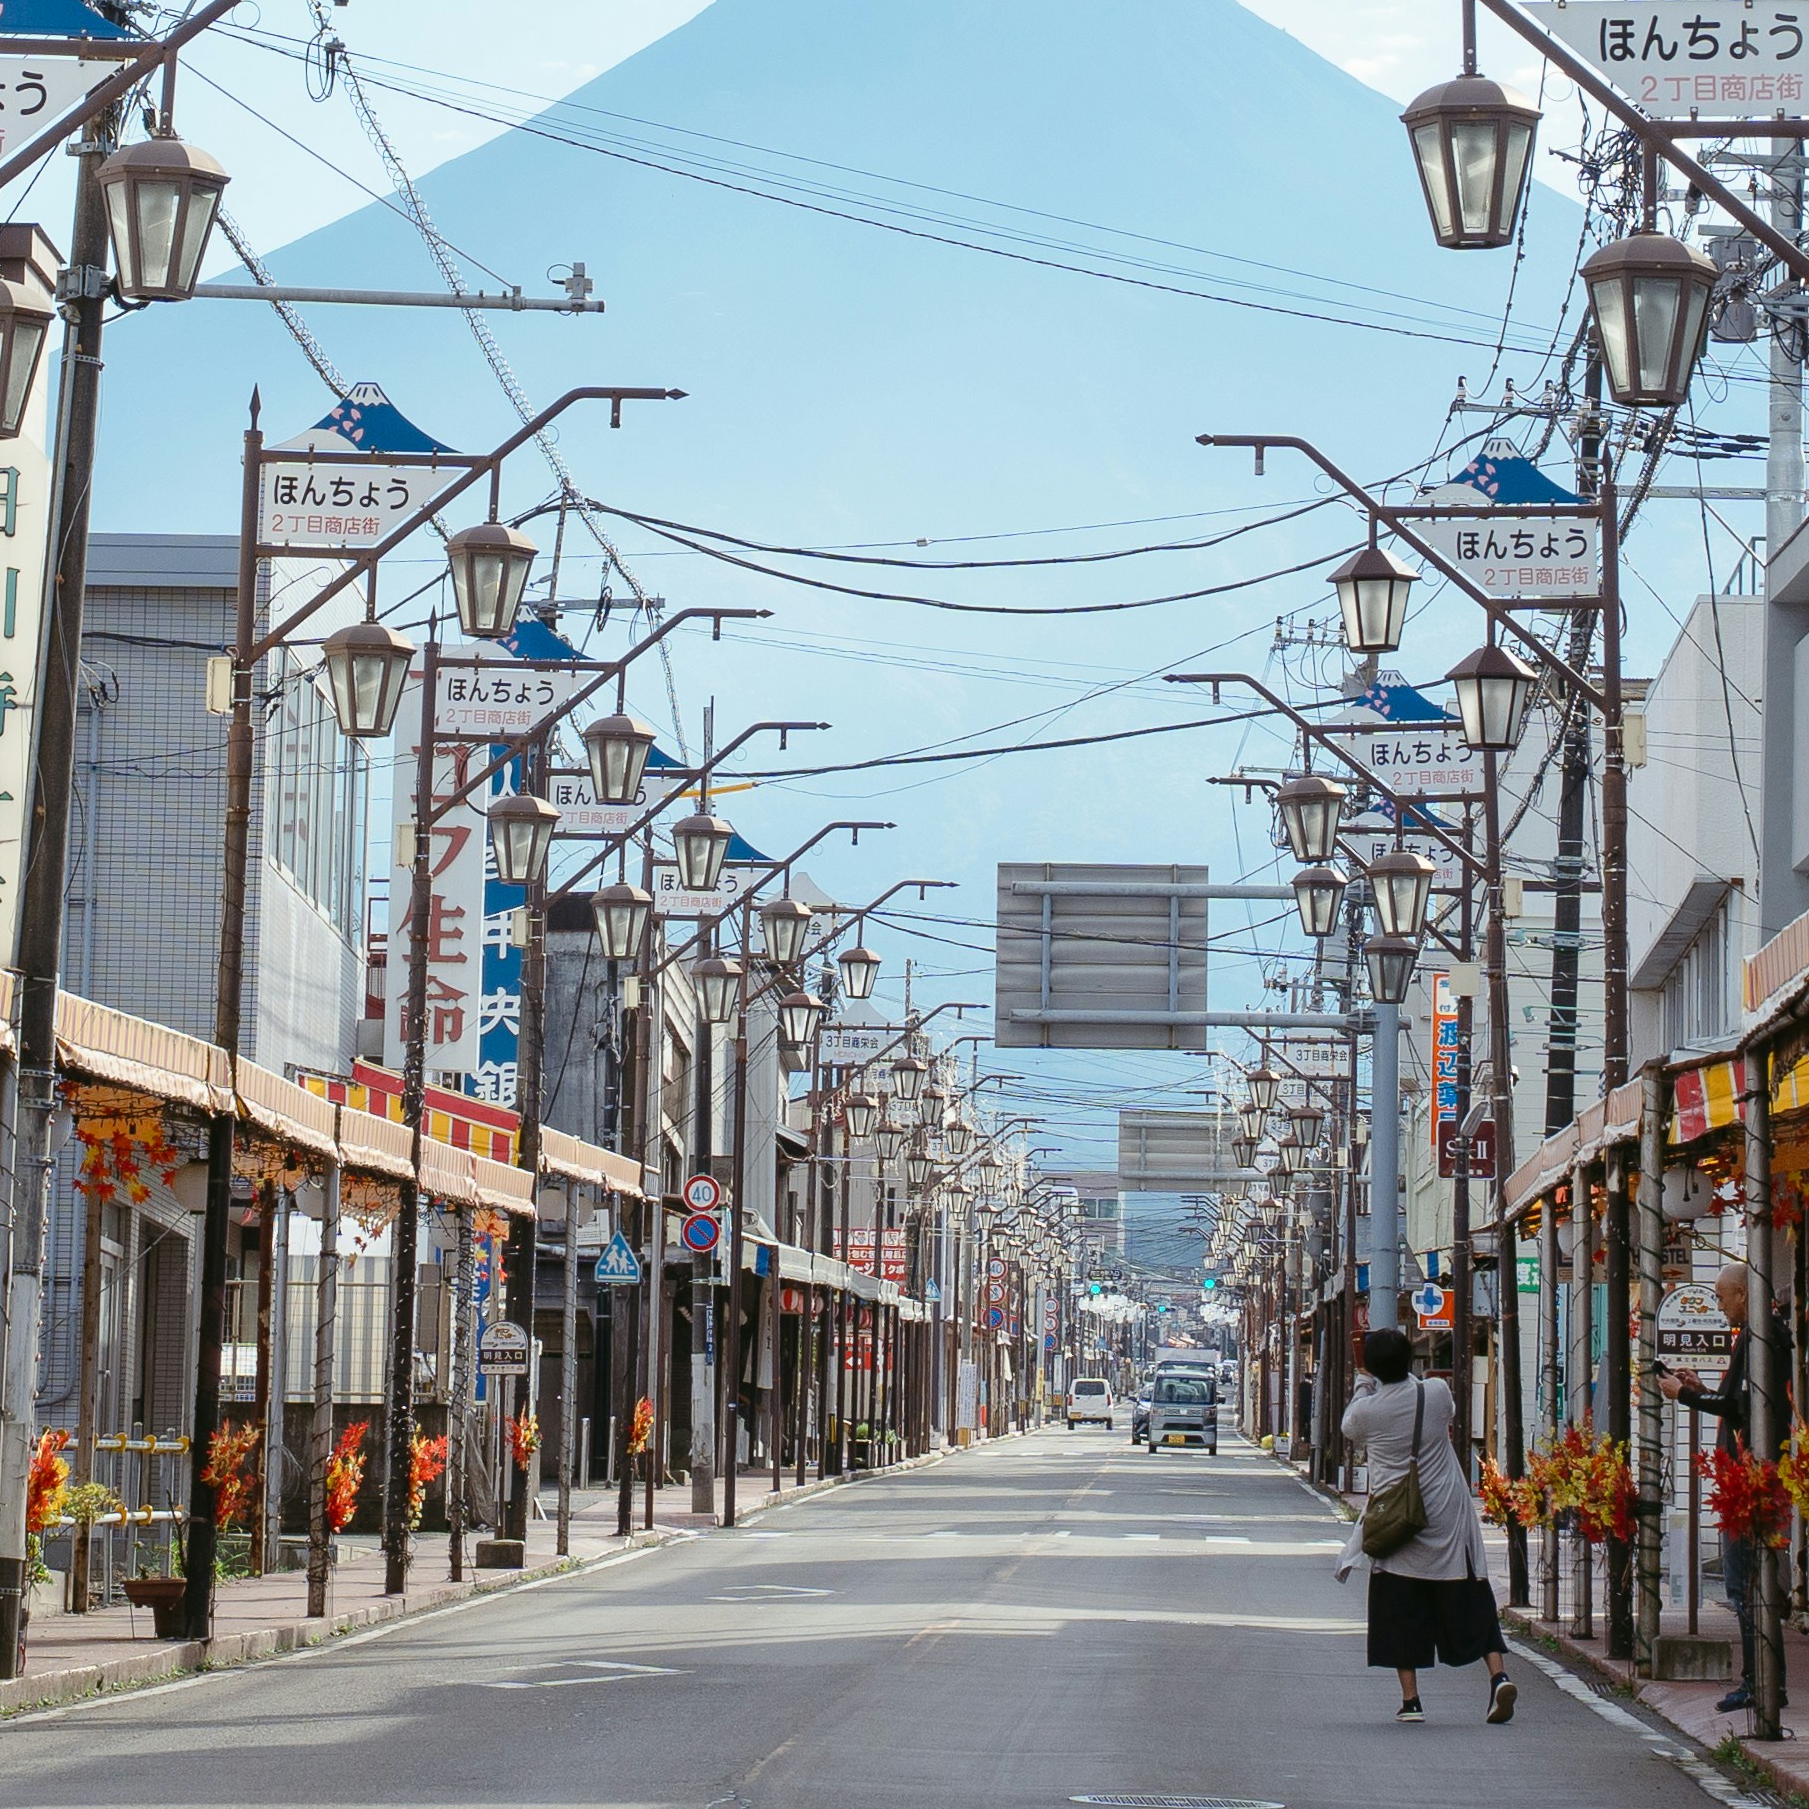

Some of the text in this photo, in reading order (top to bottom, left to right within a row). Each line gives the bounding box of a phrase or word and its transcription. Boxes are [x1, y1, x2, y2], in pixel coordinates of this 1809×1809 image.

[1599, 13, 1804, 63] ほんちょう
[1640, 73, 1804, 103] 2丁目商店街
[274, 473, 410, 511] ほんちょう
[271, 513, 380, 536] 2丁目商店街
[1455, 527, 1589, 561] ほんちょう
[1484, 566, 1590, 587] 2丁目商店街
[447, 676, 555, 707] ほんちょう
[445, 708, 532, 726] 2丁目商店街
[1392, 770, 1475, 786] 2丁目商店街
[556, 783, 647, 805] ほんう
[692, 1186, 712, 1202] 40
[1662, 1333, 1725, 1347] 明見入口
